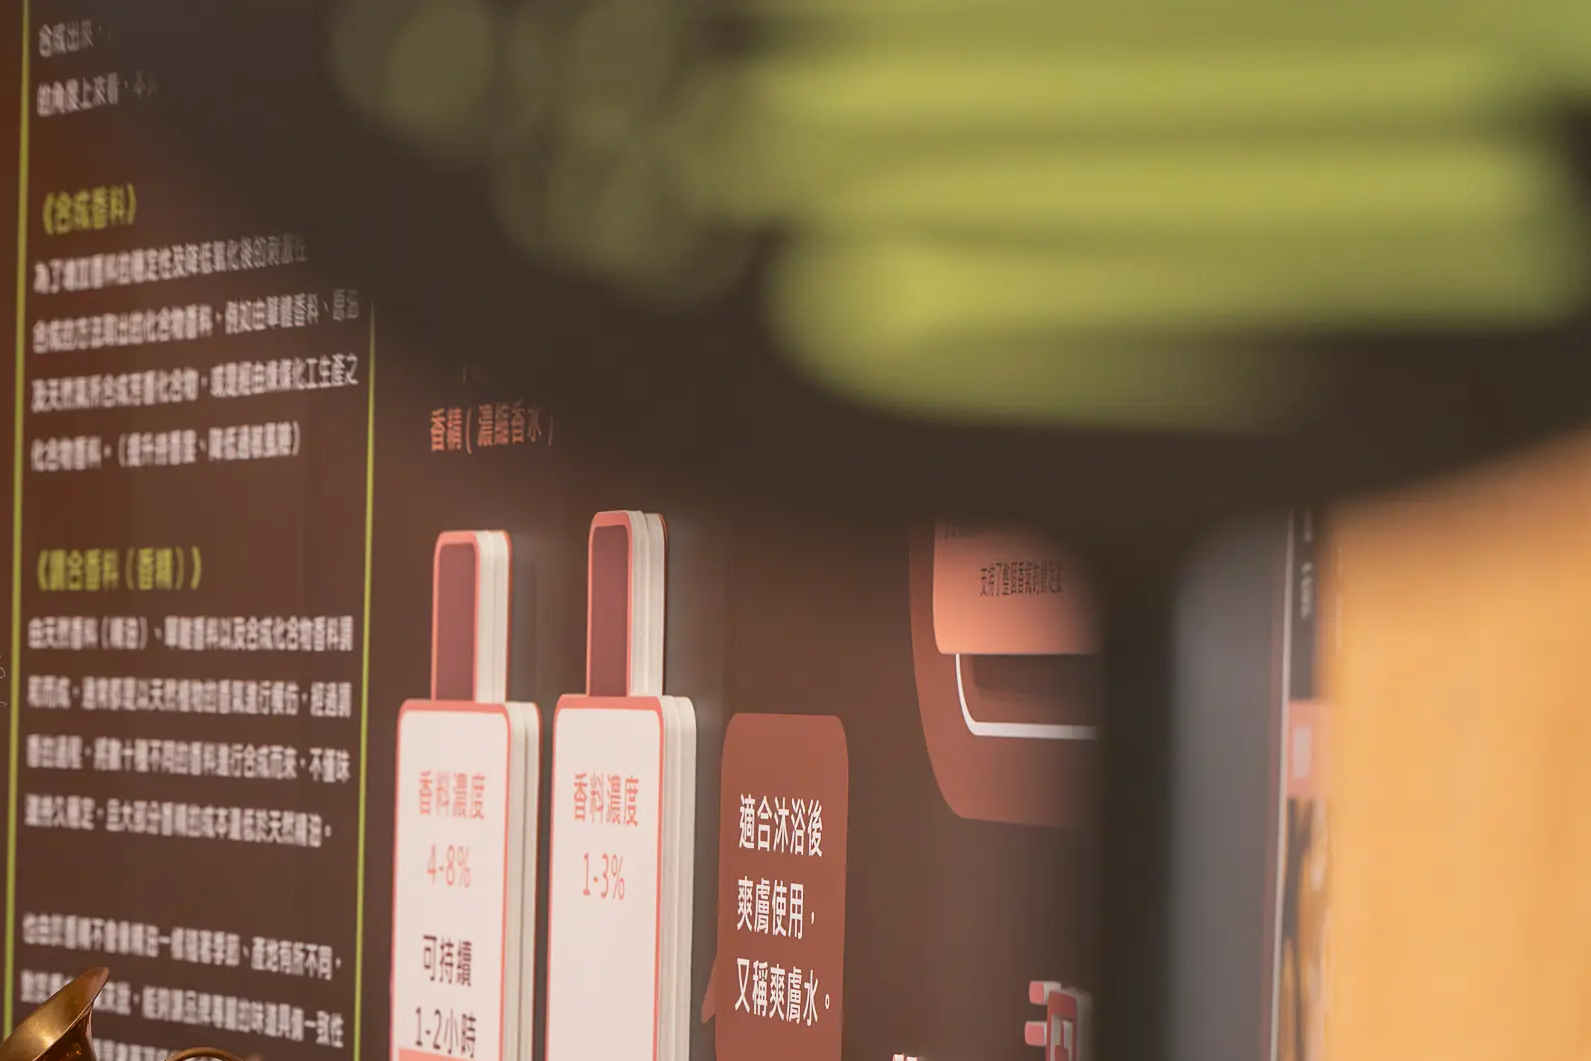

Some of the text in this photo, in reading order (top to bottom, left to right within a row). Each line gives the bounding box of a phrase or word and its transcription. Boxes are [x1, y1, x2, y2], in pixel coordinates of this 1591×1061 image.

[417, 769, 486, 820] 香料濃度
[572, 772, 640, 828] 香料濃度
[738, 793, 824, 858] 適合沐浴後
[427, 844, 472, 889] 4-8%
[581, 852, 626, 901] 1-3%
[735, 878, 816, 940] 爽膚使用，
[421, 933, 473, 988] 可持續
[733, 957, 832, 1026] 又稱爽膚水。
[414, 1006, 478, 1060] 1-2小時
